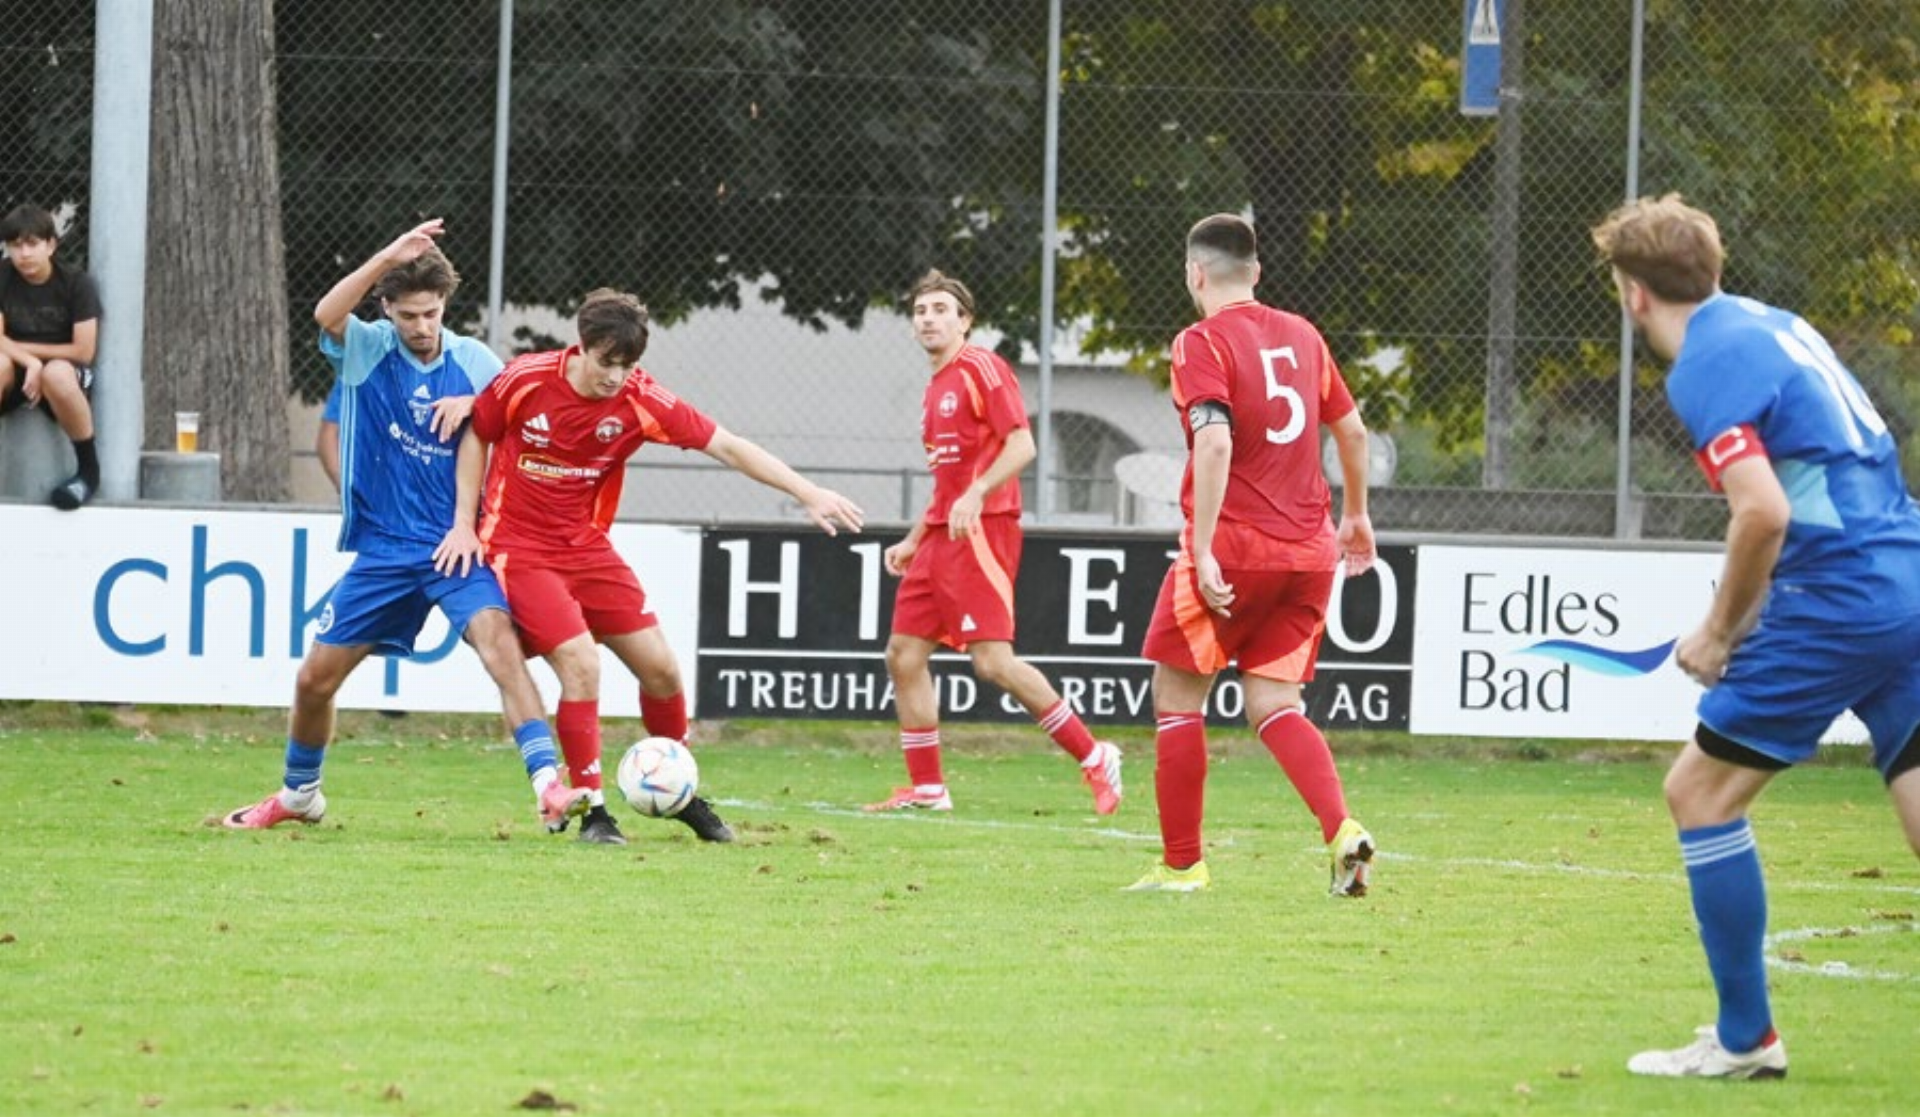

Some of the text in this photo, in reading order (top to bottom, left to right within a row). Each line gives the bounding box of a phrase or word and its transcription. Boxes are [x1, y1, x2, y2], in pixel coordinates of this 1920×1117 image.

[1260, 346, 1306, 444] 5
[1462, 572, 1620, 637] Edles
[1328, 682, 1390, 722] AG
[1459, 649, 1571, 713] Bad
